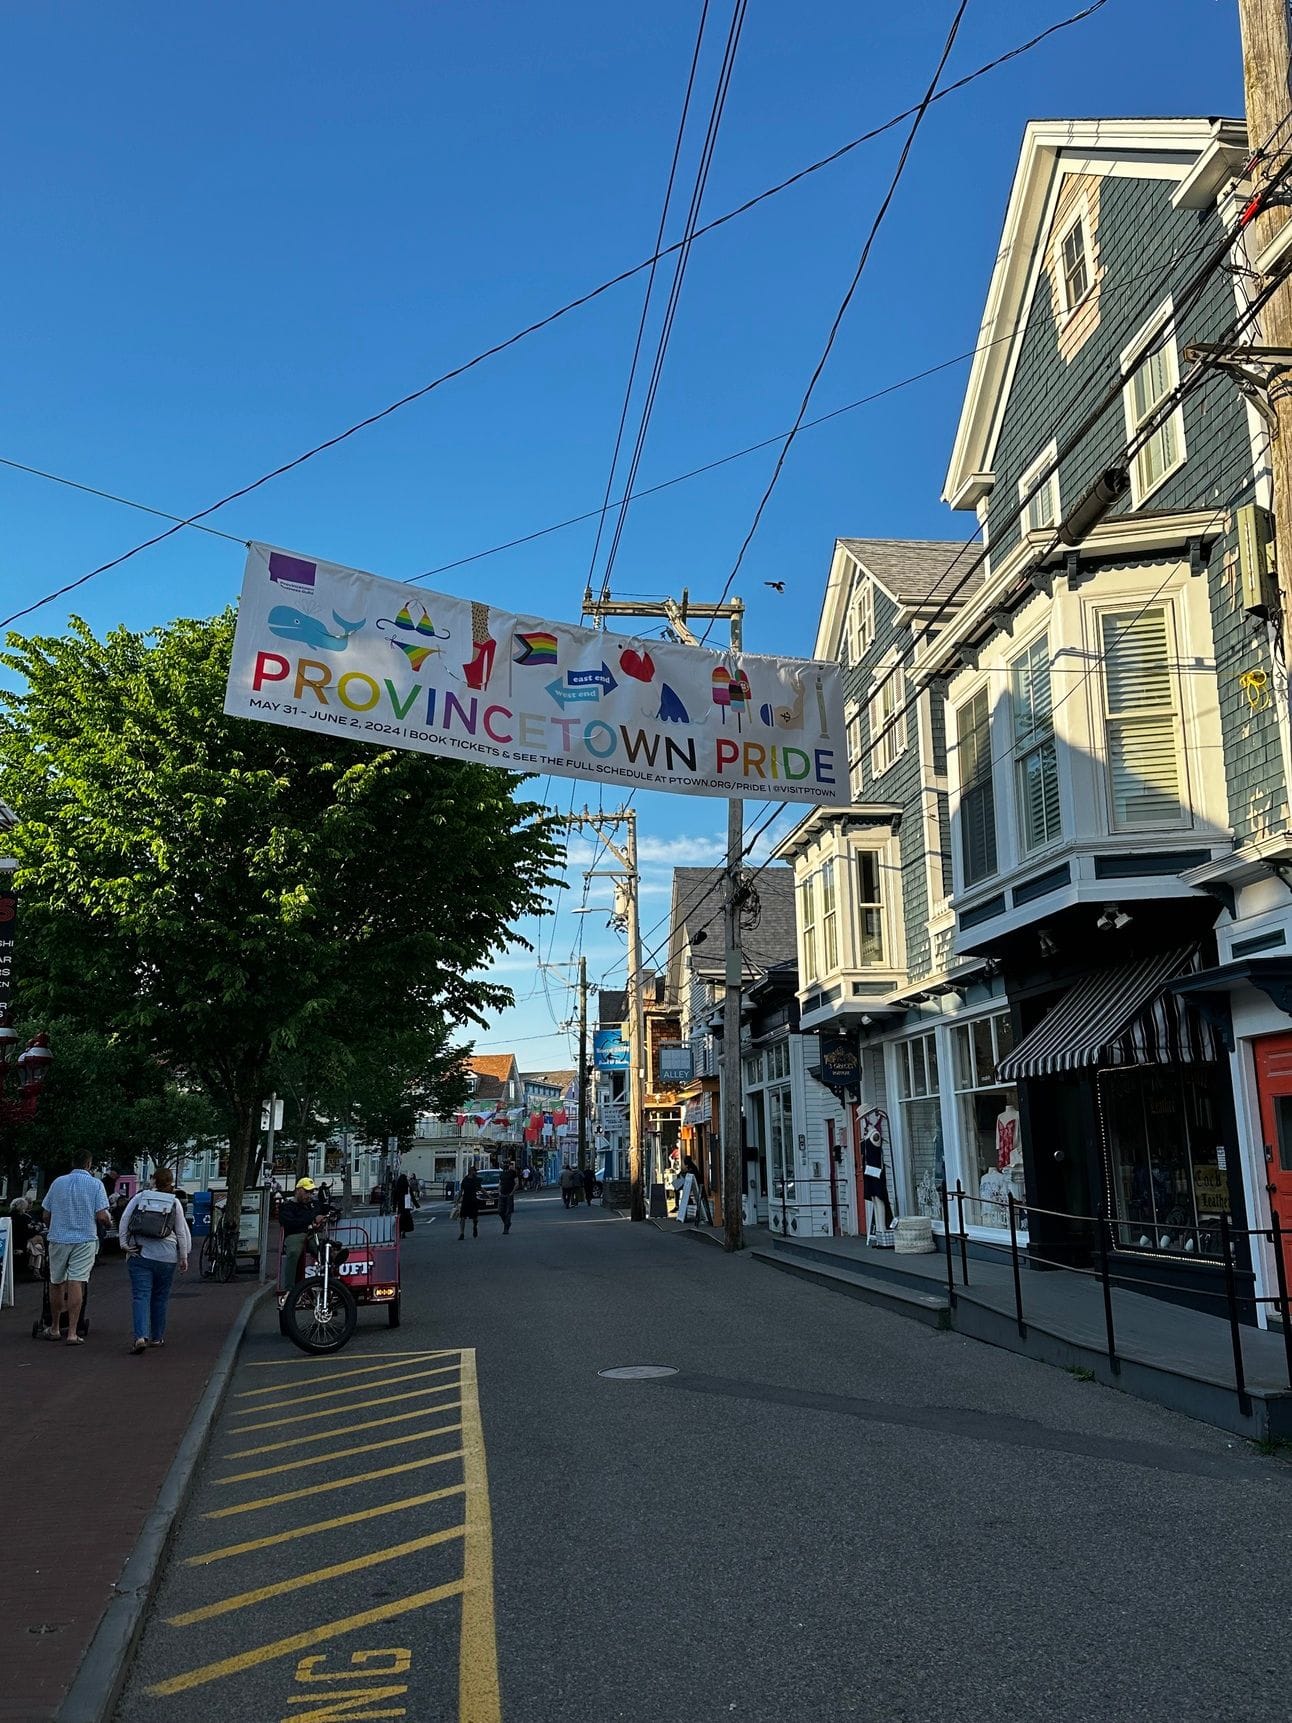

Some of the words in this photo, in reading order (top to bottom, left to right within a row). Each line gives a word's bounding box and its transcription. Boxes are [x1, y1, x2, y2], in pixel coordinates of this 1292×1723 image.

[573, 675, 593, 683] east
[594, 676, 610, 684] end
[554, 690, 577, 699] west
[252, 651, 697, 772] PROVINCETOWN
[716, 738, 836, 784] PRIDE
[250, 699, 281, 711] MAY
[283, 704, 298, 715] 31
[309, 711, 347, 726] JUNE
[350, 719, 362, 729] 2,
[365, 721, 401, 737] 2024
[409, 730, 448, 745] BOOK
[450, 738, 500, 757] TICKETS
[502, 751, 510, 759] &
[513, 752, 538, 763] SEE
[540, 756, 564, 767] THE
[566, 759, 595, 772] FULL
[596, 764, 653, 782] SCHEDULE
[654, 775, 668, 783] AT
[669, 777, 767, 793] PTOWN.ORG/PRIDE
[773, 784, 836, 798] @VISITPTOWN
[663, 1071, 690, 1079] ALLEY
